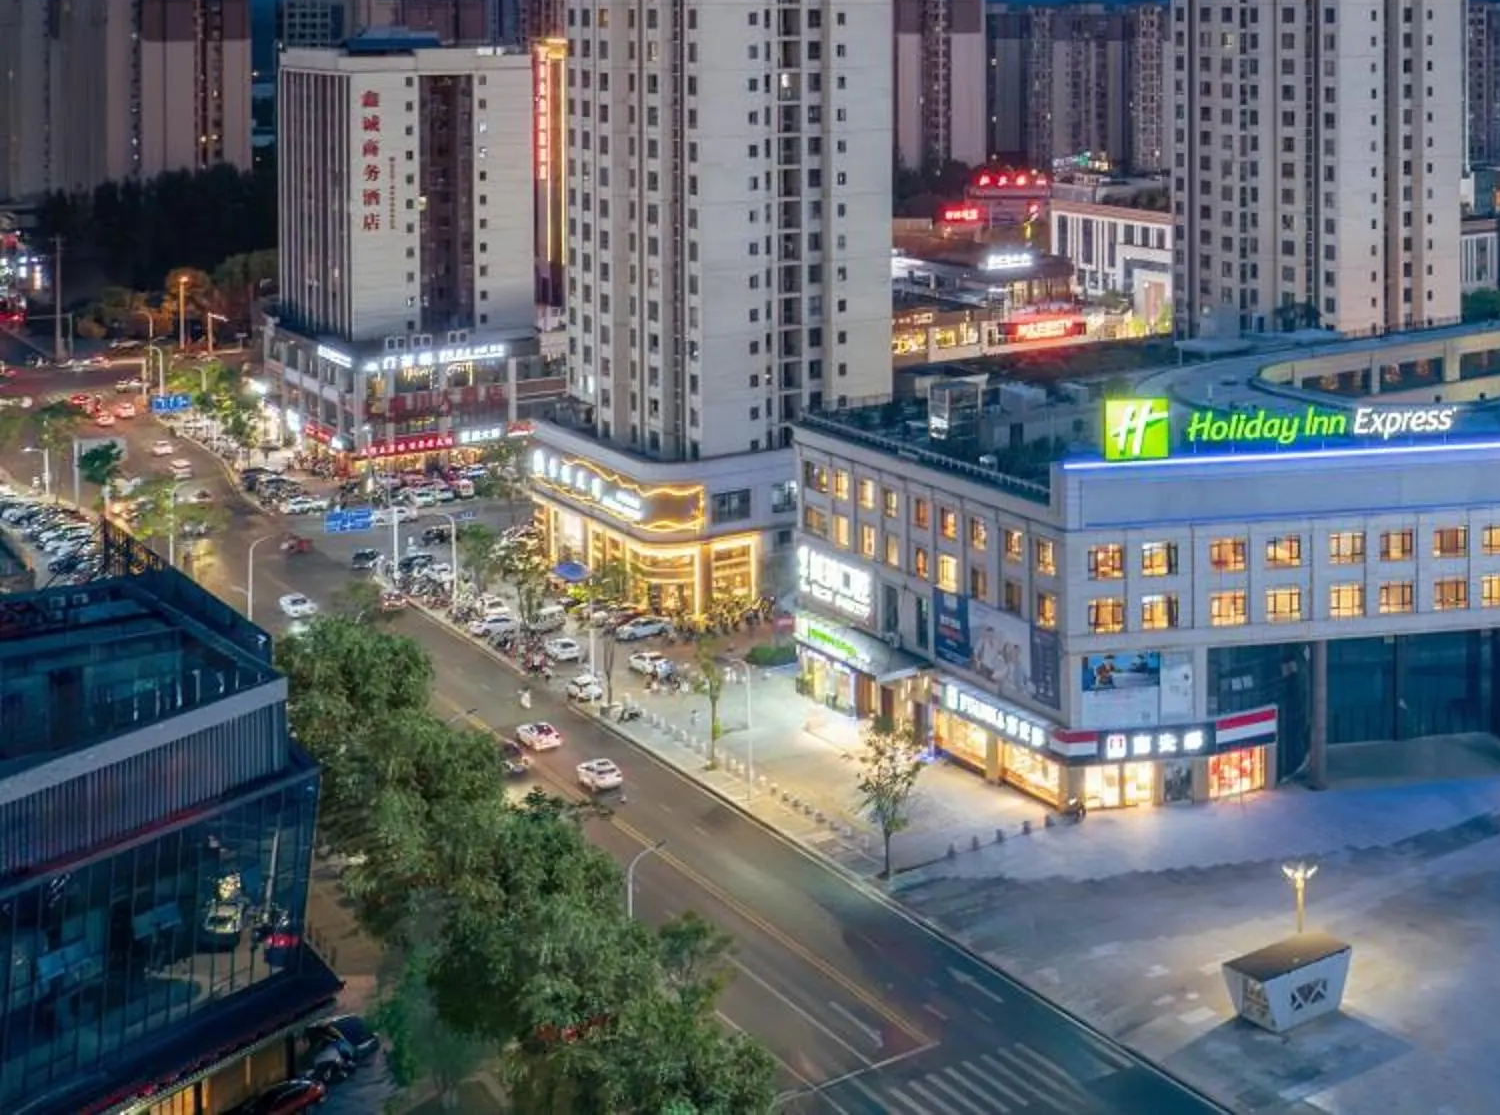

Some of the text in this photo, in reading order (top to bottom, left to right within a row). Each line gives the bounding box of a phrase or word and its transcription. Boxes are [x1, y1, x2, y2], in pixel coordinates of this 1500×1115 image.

[1186, 408, 1300, 444] Holiday
[1304, 405, 1346, 438] Inn
[1353, 406, 1453, 439] Express
